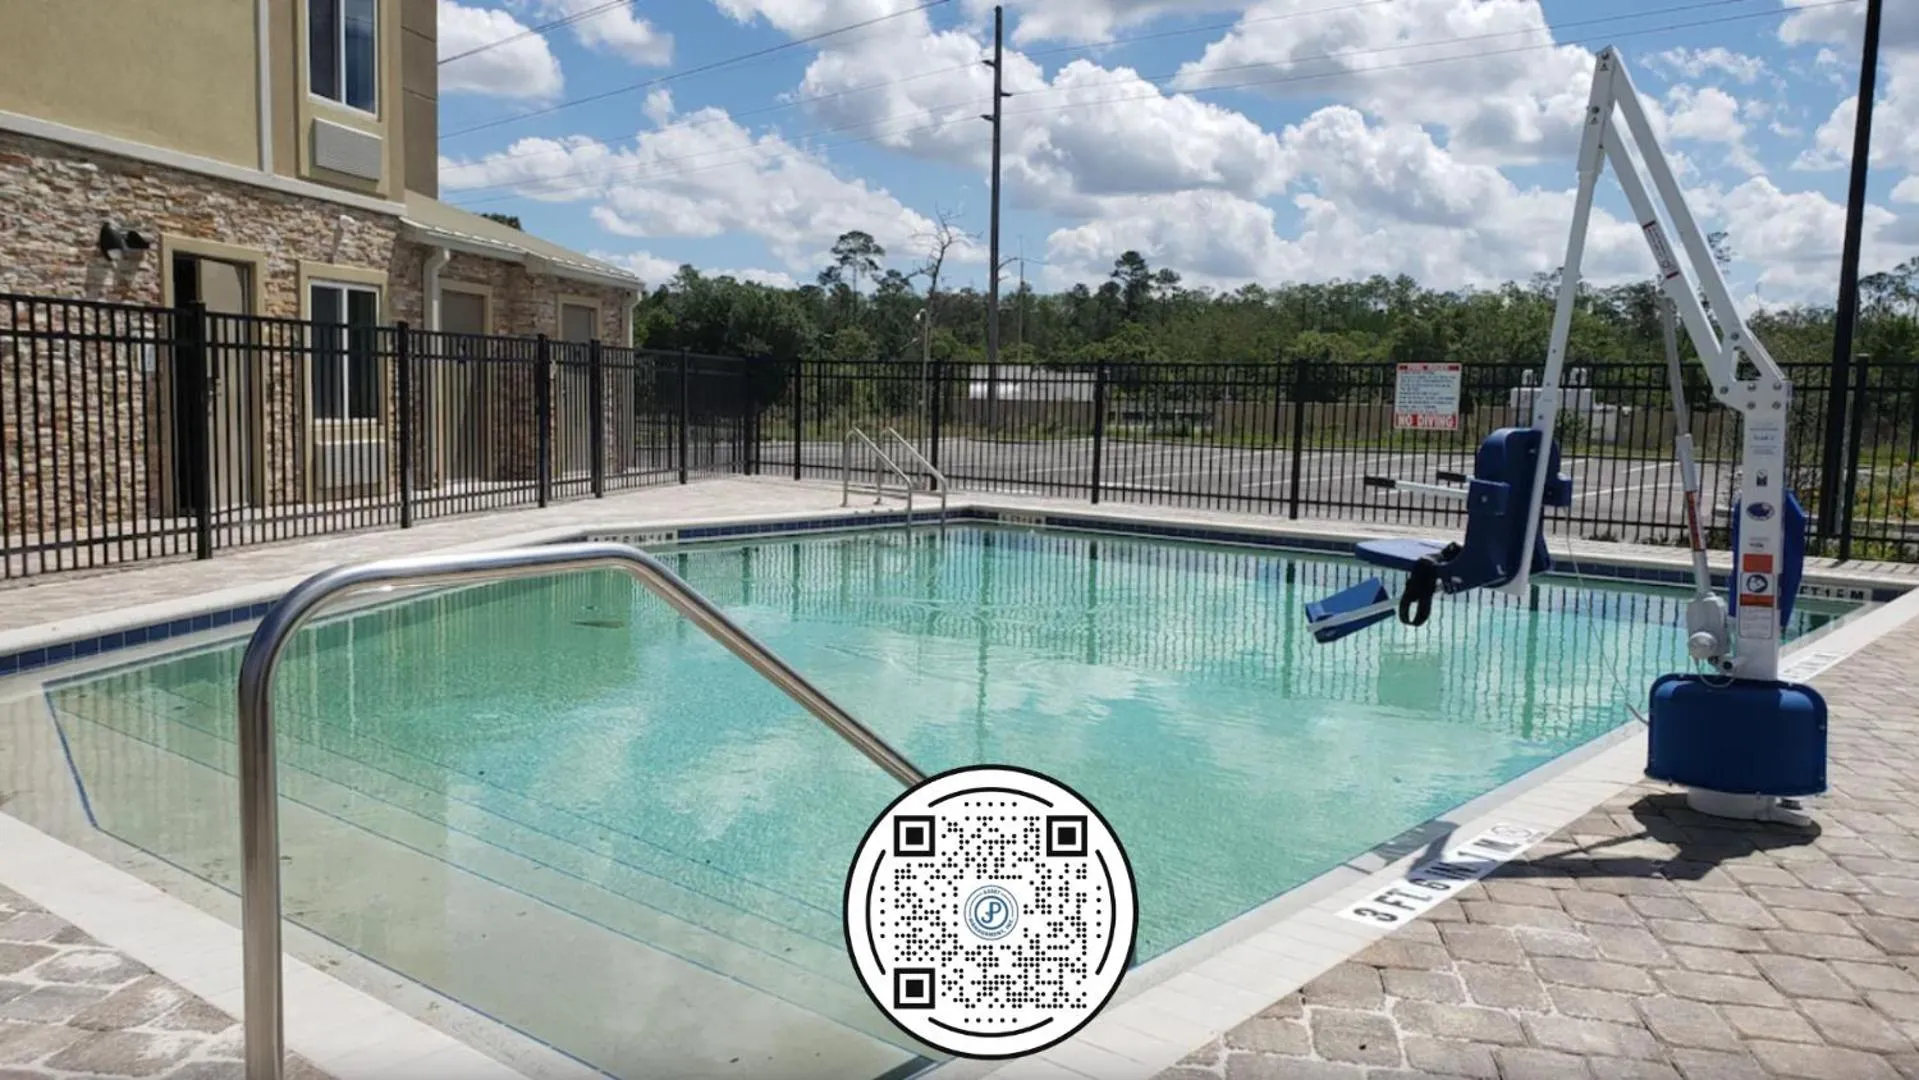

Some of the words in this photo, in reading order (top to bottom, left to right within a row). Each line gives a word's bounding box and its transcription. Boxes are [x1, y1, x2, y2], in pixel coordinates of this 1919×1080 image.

[1399, 414, 1413, 427] NO
[1416, 414, 1454, 428] DIVING
[1850, 590, 1864, 599] M
[1408, 878, 1451, 891] 6
[1374, 888, 1433, 911] FT
[1353, 907, 1398, 922] 3
